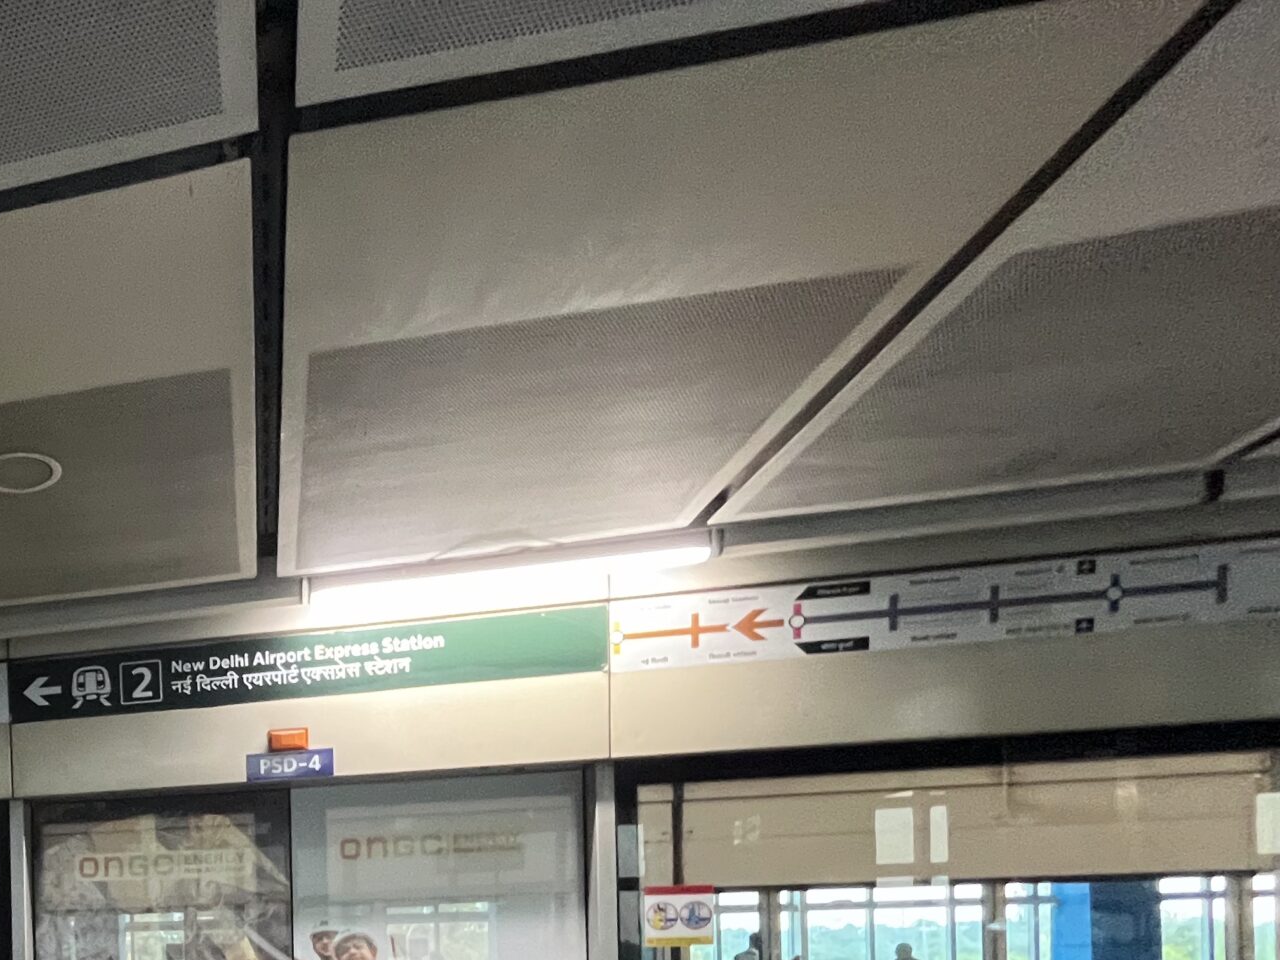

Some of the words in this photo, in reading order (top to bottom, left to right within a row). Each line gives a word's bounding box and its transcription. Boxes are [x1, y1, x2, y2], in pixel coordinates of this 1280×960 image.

[171, 660, 205, 674] New
[209, 652, 249, 671] Delhi
[253, 645, 312, 669] Airport
[315, 642, 380, 663] Express
[382, 633, 446, 654] Station
[131, 666, 154, 699] 2
[171, 674, 192, 695] नई
[196, 670, 239, 692] दिल्ली
[242, 663, 299, 690] एयरपोर्ट
[301, 659, 361, 685] एक्सप्रेस
[364, 655, 412, 678] स्टेशन
[259, 754, 322, 775] PSD-4
